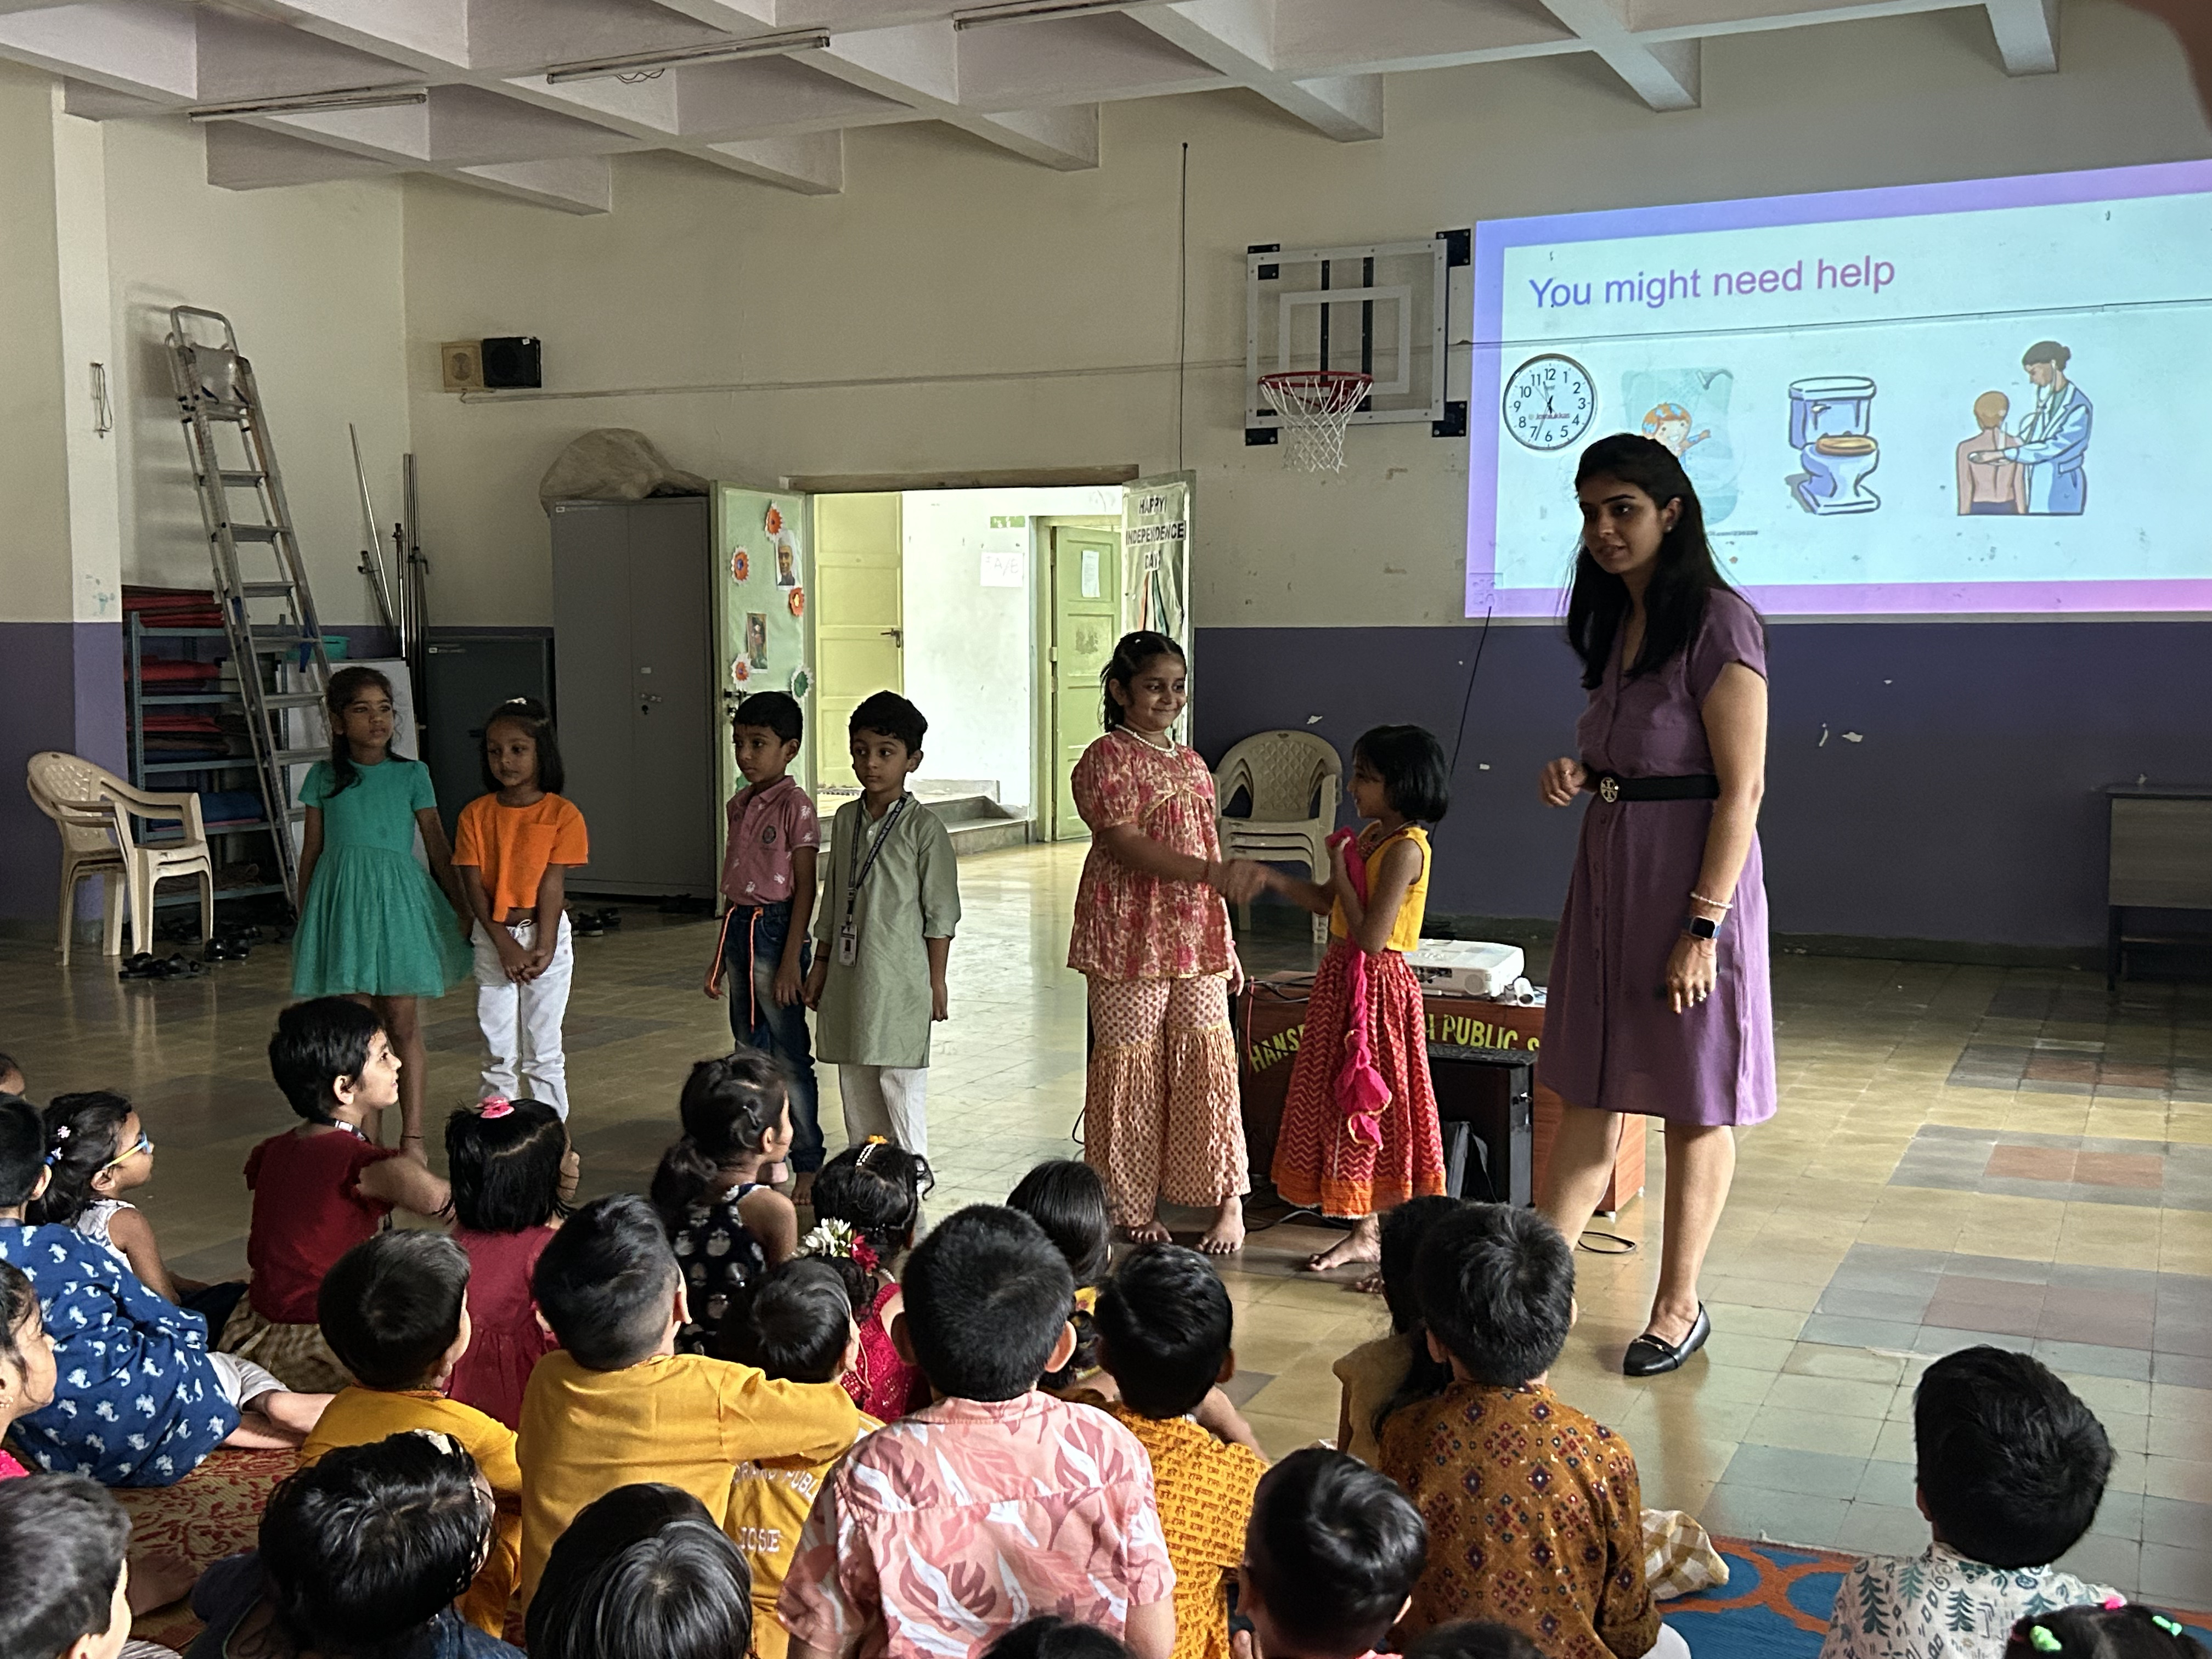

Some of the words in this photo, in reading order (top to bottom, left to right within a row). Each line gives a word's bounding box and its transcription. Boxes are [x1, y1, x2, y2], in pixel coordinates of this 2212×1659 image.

[1530, 278, 1592, 308] You
[1605, 268, 1701, 309] might
[1714, 260, 1803, 296] need
[1817, 256, 1895, 294] help
[1531, 374, 1541, 386] 11
[1544, 368, 1556, 381] 12
[1563, 371, 1567, 383] 1
[1520, 386, 1532, 398] 10
[1573, 382, 1581, 394] 2
[1514, 401, 1521, 413] 9
[1578, 398, 1585, 410] 3
[1519, 416, 1526, 428] 8
[1572, 414, 1580, 426] 4
[1530, 426, 1538, 438] 7
[1545, 430, 1553, 442] 6
[1560, 425, 1568, 438] 5
[1126, 523, 1184, 545] INDEPENDENCE
[1442, 1014, 1519, 1050] PUBLIC
